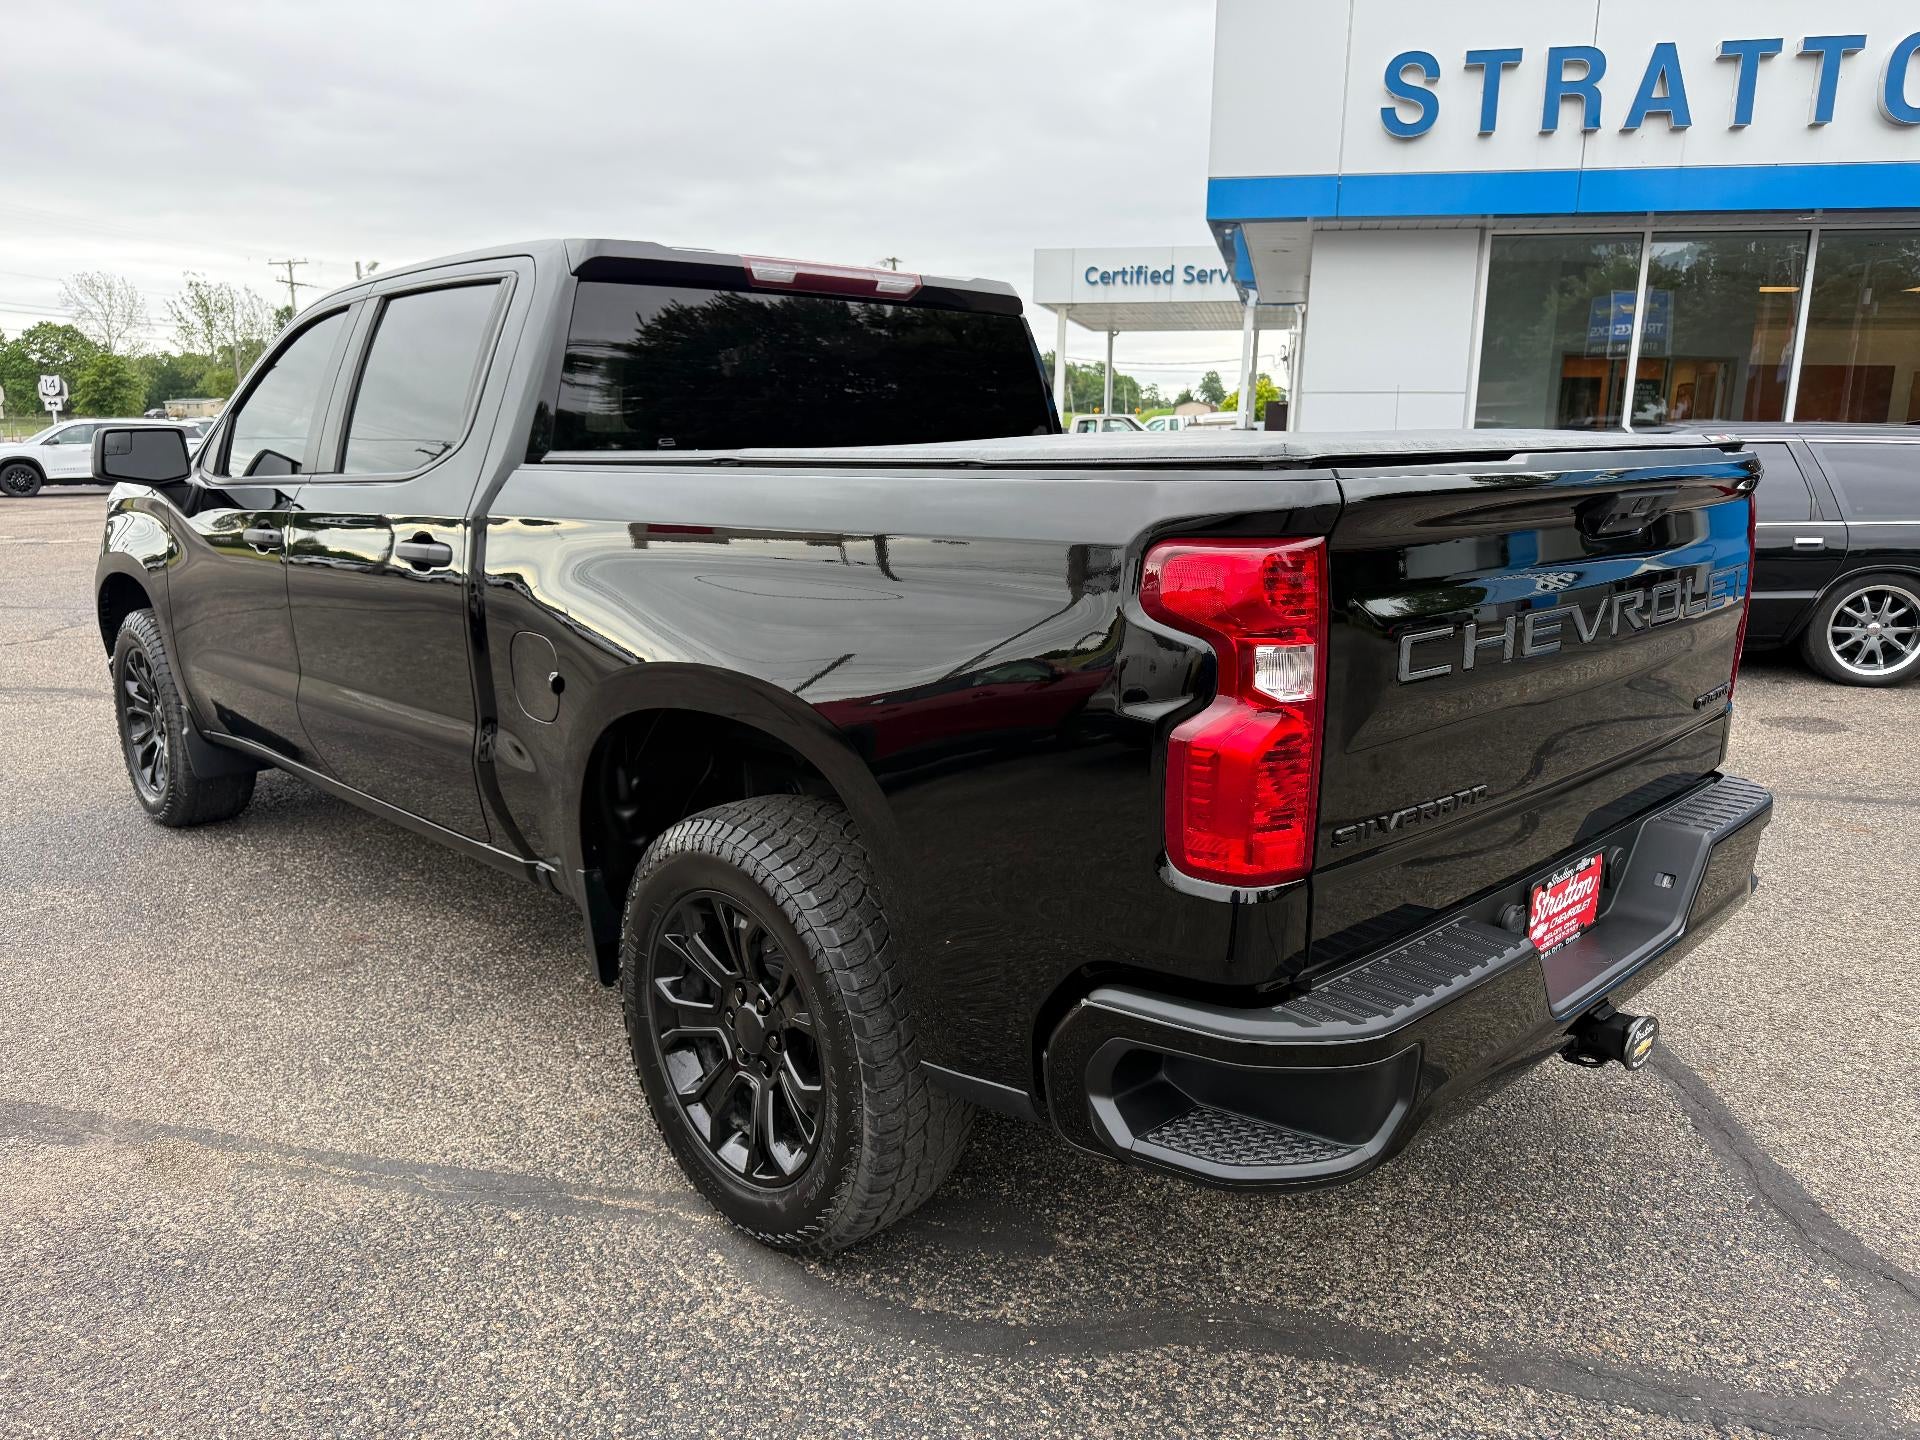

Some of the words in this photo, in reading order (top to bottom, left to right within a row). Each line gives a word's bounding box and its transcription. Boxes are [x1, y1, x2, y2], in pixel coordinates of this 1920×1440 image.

[1085, 264, 1175, 286] Certified
[44, 379, 56, 391] 14
[1398, 563, 1747, 683] CHEVROLET
[1331, 784, 1488, 848] SILVERADO
[1530, 873, 1598, 927] Stratton
[1549, 897, 1593, 929] CHEVROLET
